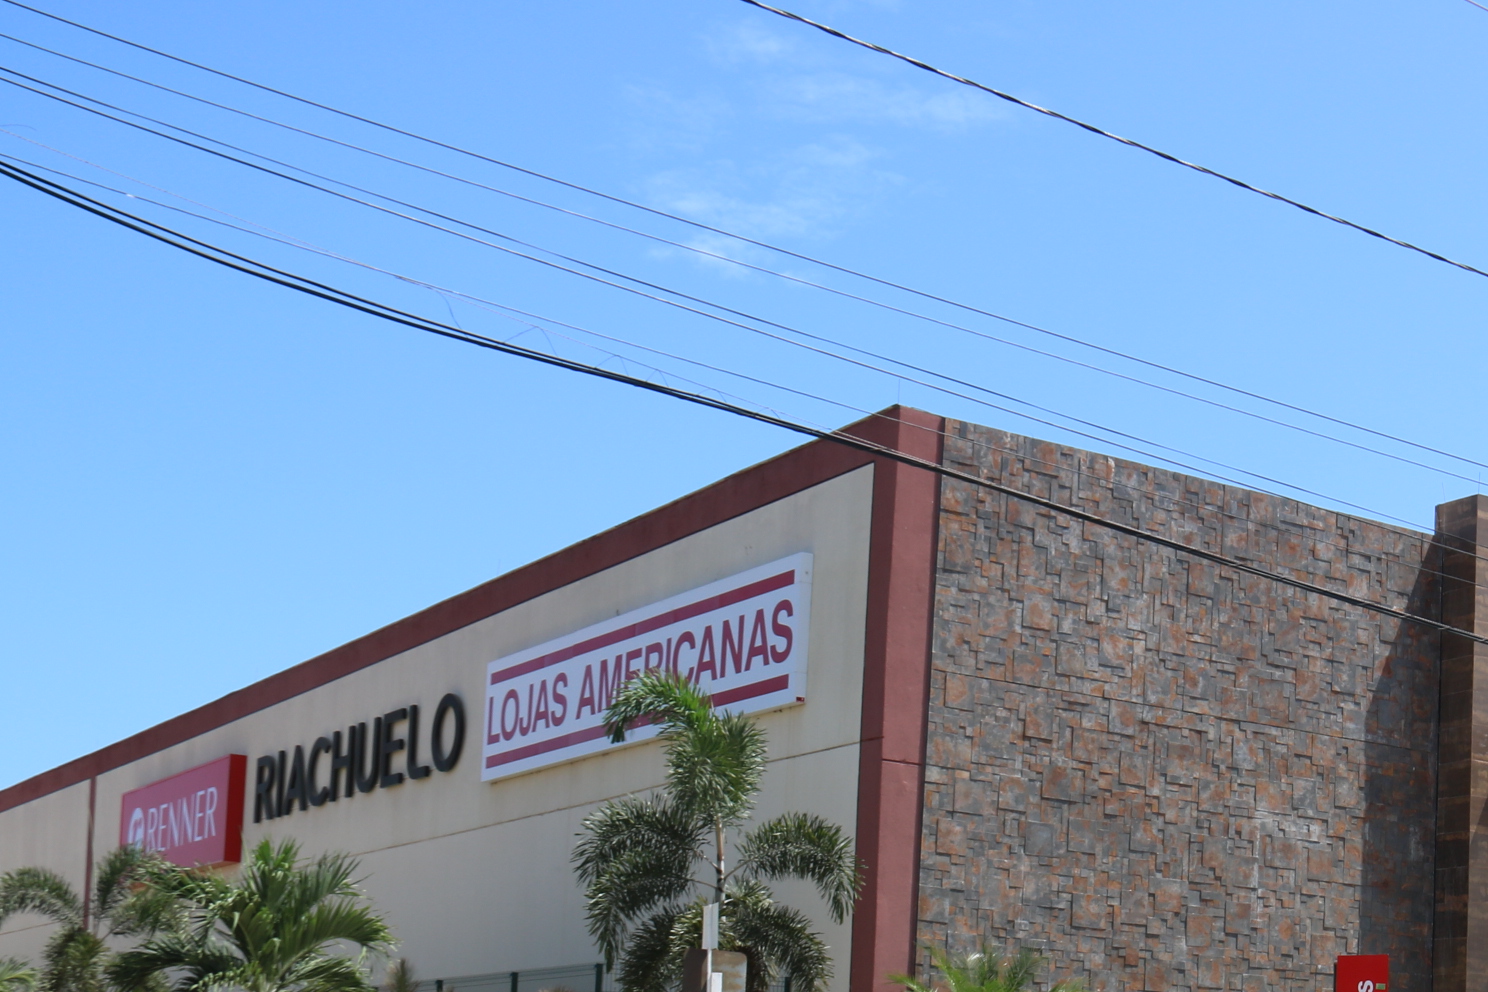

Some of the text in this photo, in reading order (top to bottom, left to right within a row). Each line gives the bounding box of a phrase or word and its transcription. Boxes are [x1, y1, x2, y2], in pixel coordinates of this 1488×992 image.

[487, 599, 794, 745] LOJAS AMERICANAS
[146, 787, 218, 854] RENNER
[253, 693, 465, 823] RIACHUELO
